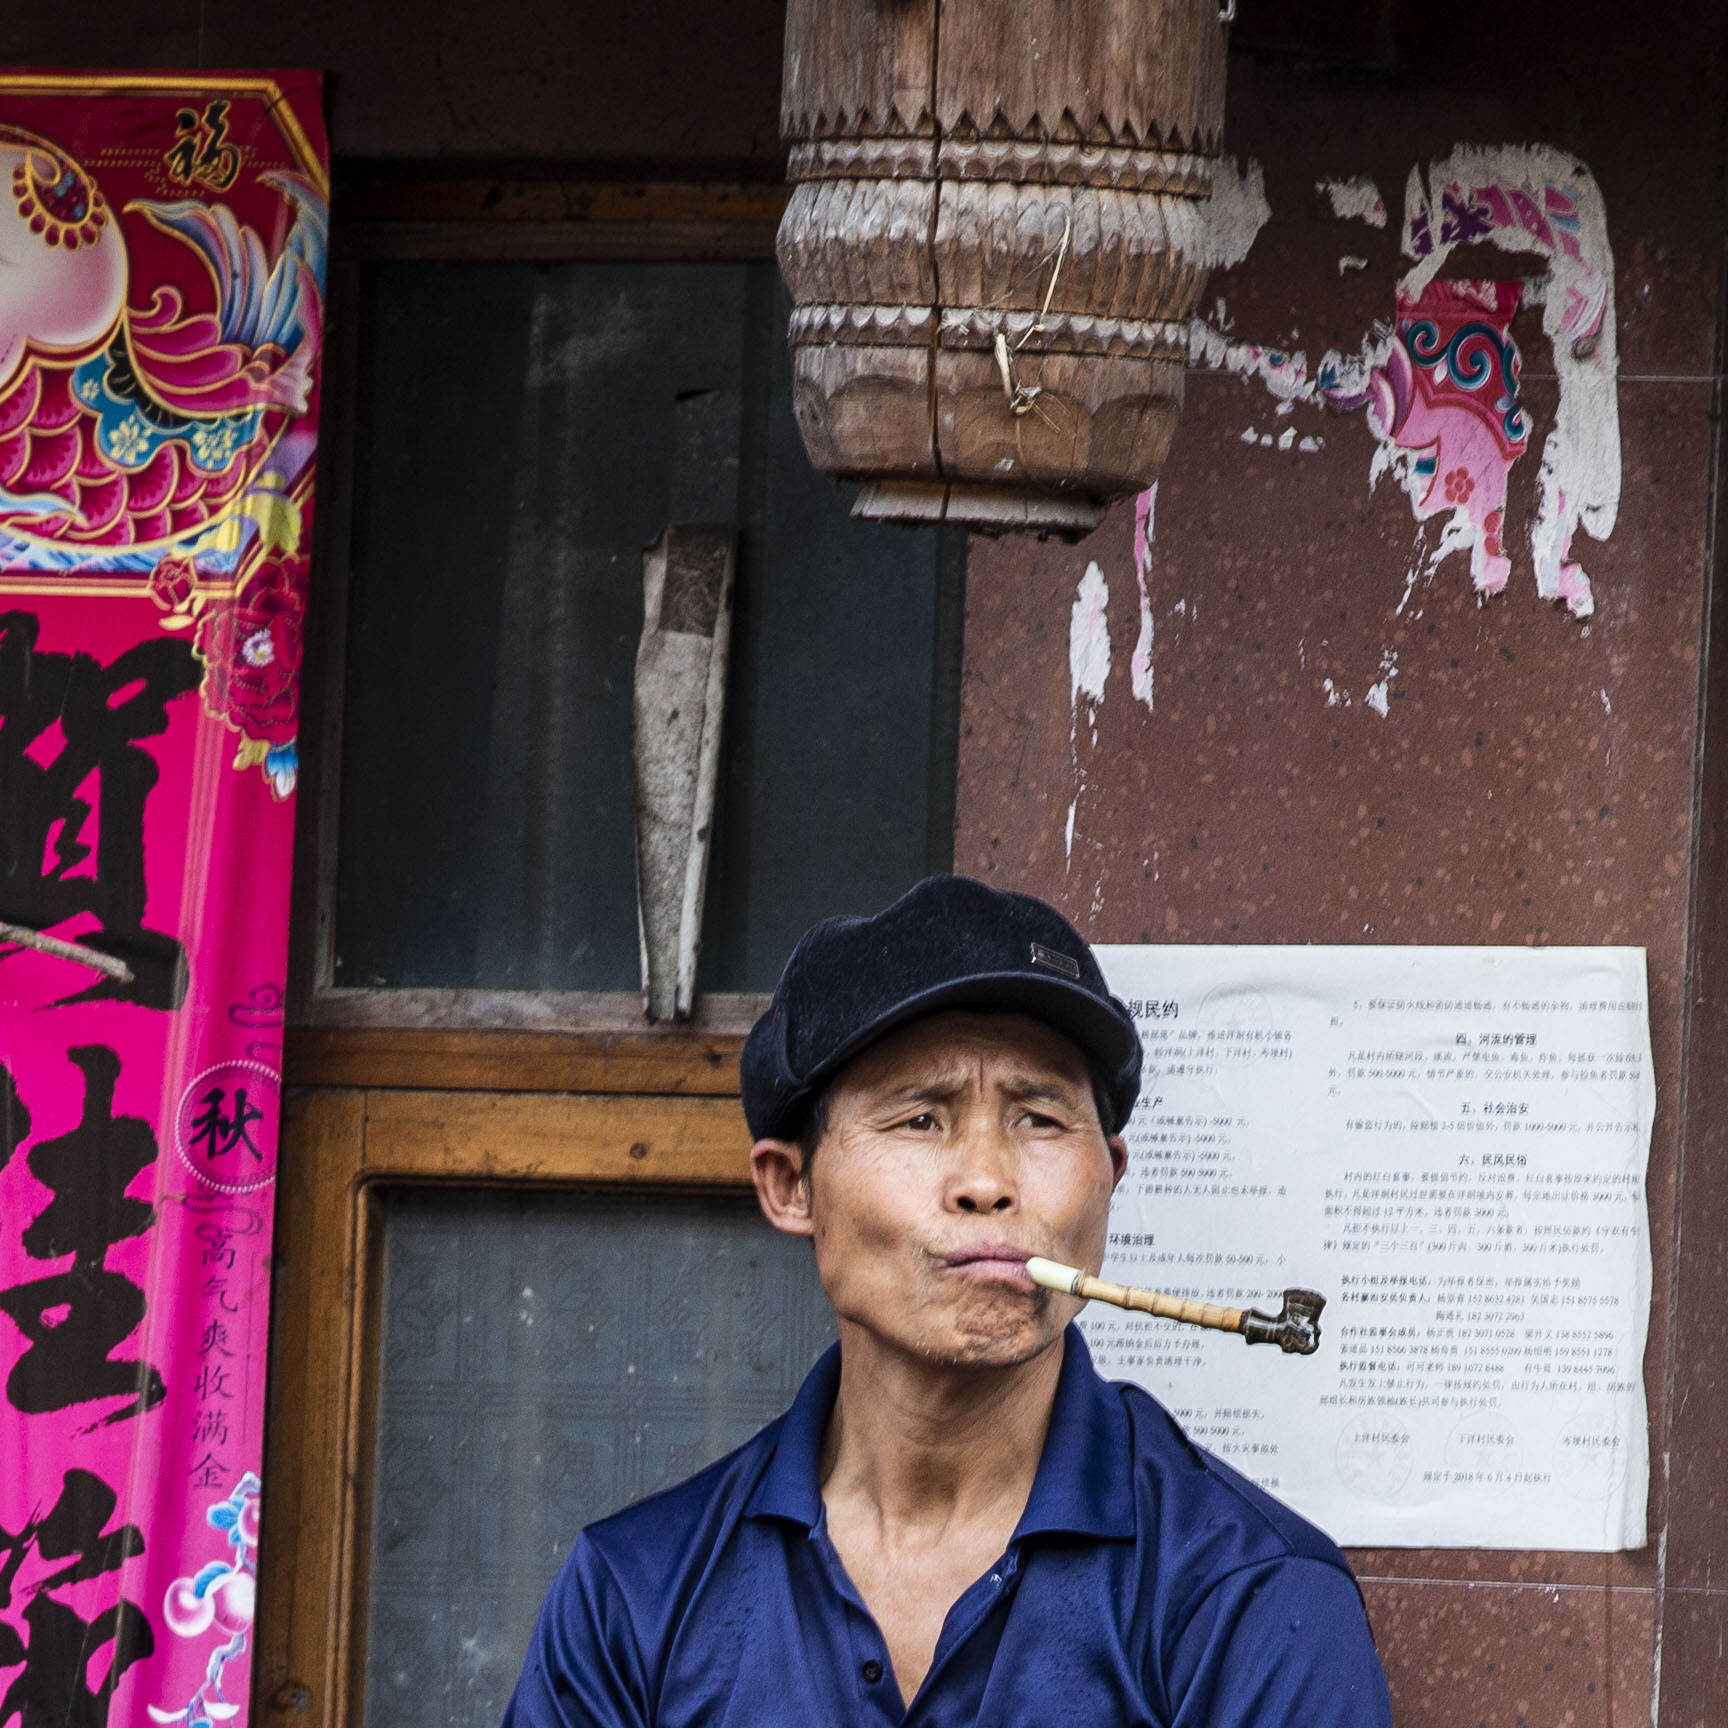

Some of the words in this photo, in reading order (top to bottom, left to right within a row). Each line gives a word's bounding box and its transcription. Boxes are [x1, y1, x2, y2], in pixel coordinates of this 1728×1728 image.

[189, 1087, 264, 1163] 秋
[1108, 1233, 1155, 1247] 环境治理
